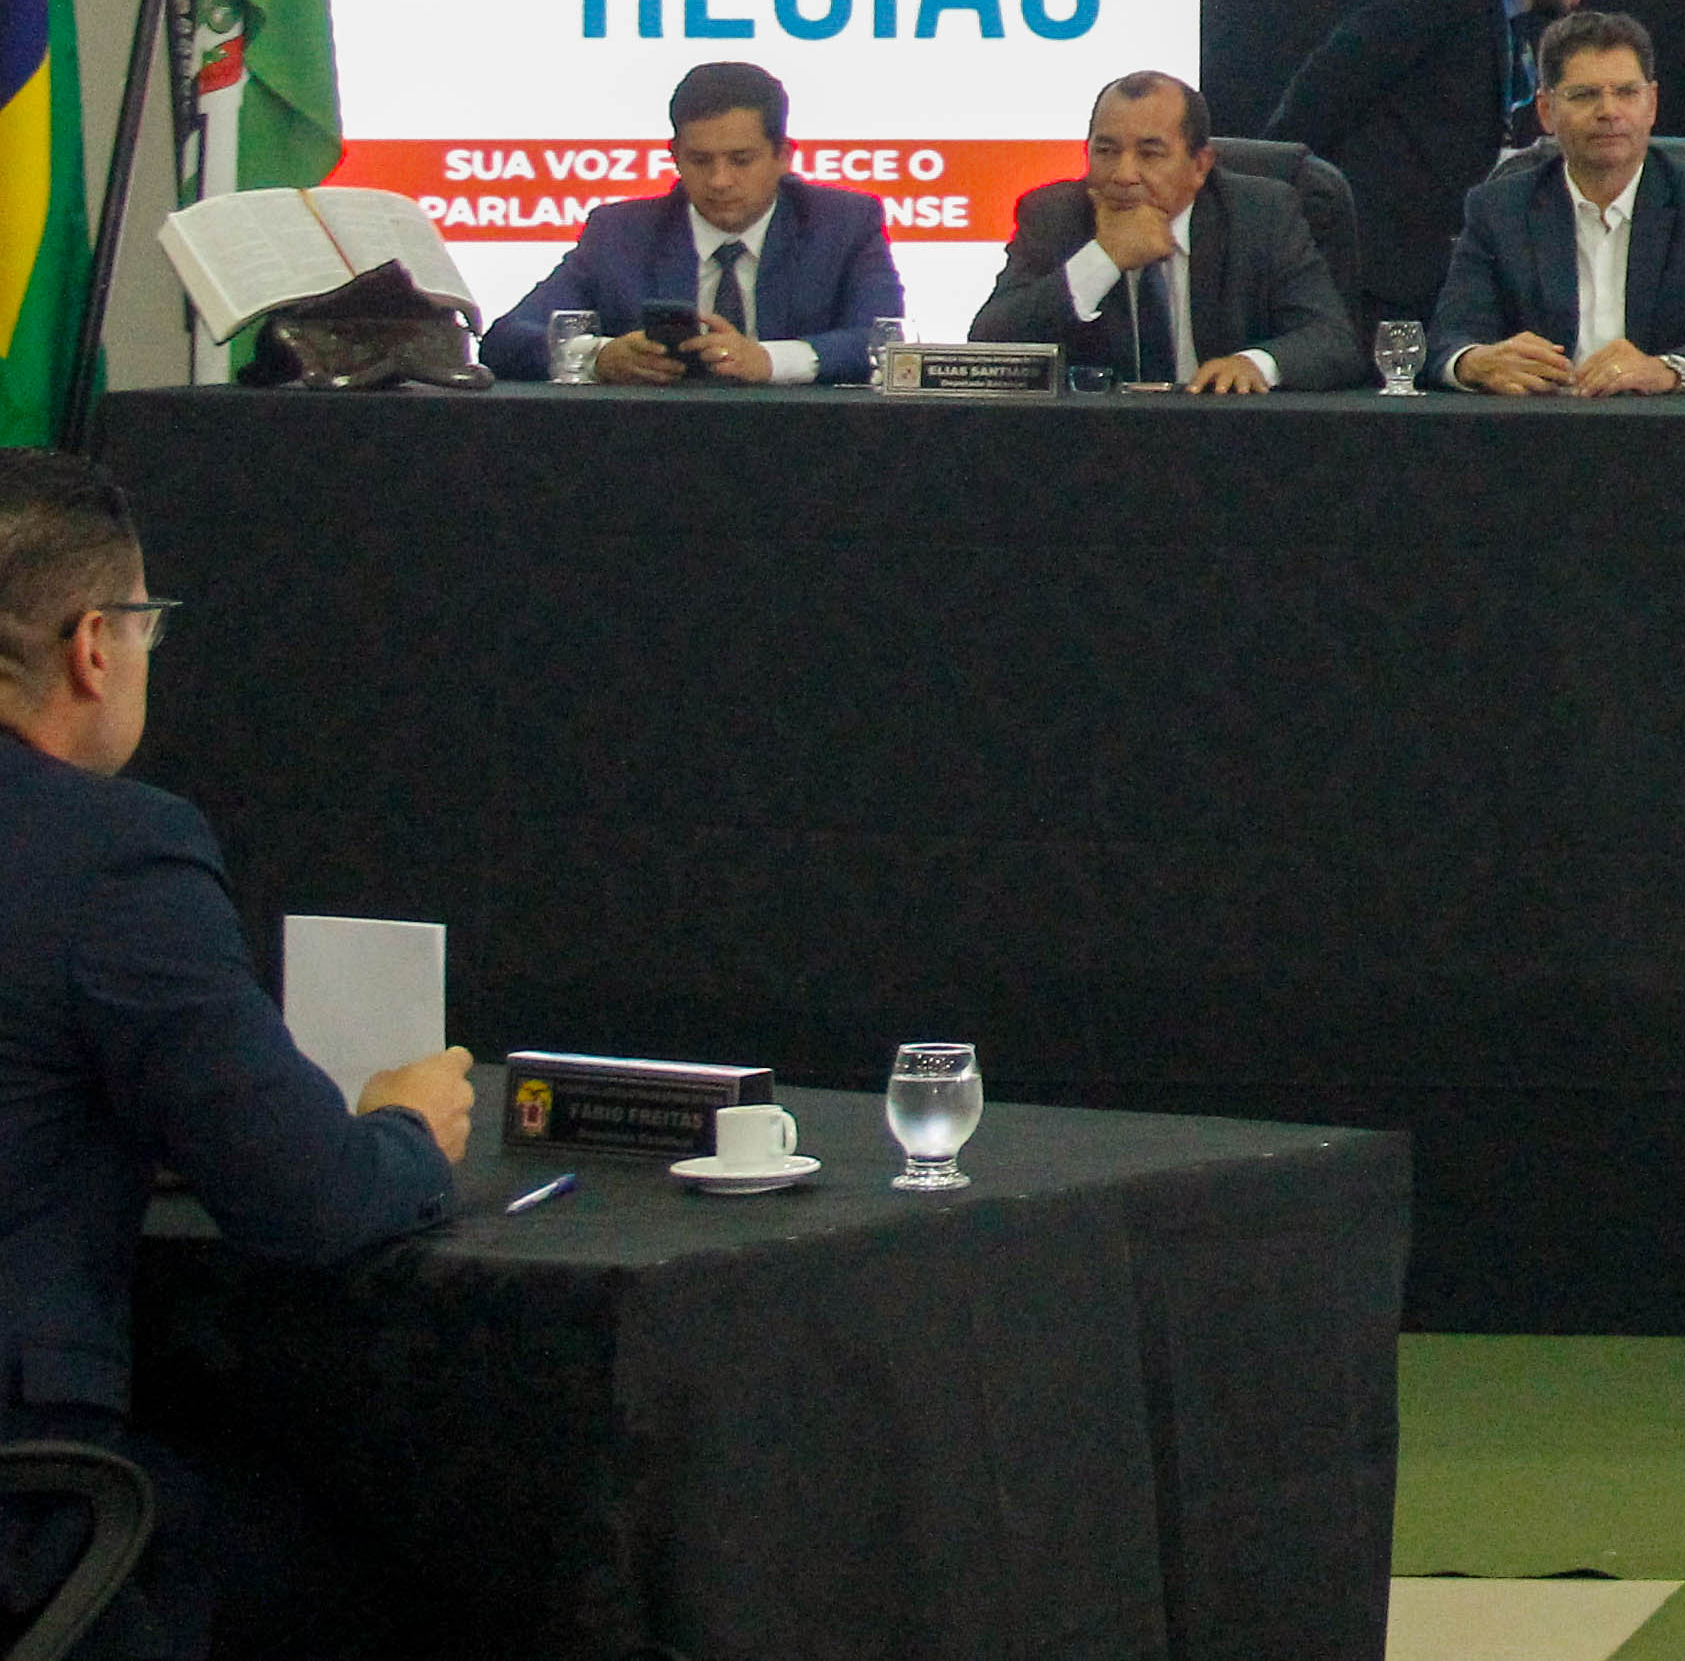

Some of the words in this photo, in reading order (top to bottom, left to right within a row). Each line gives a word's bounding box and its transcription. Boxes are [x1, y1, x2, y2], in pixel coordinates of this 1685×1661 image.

[444, 149, 537, 181] SUA
[547, 149, 638, 181] VOZ
[907, 148, 945, 181] O
